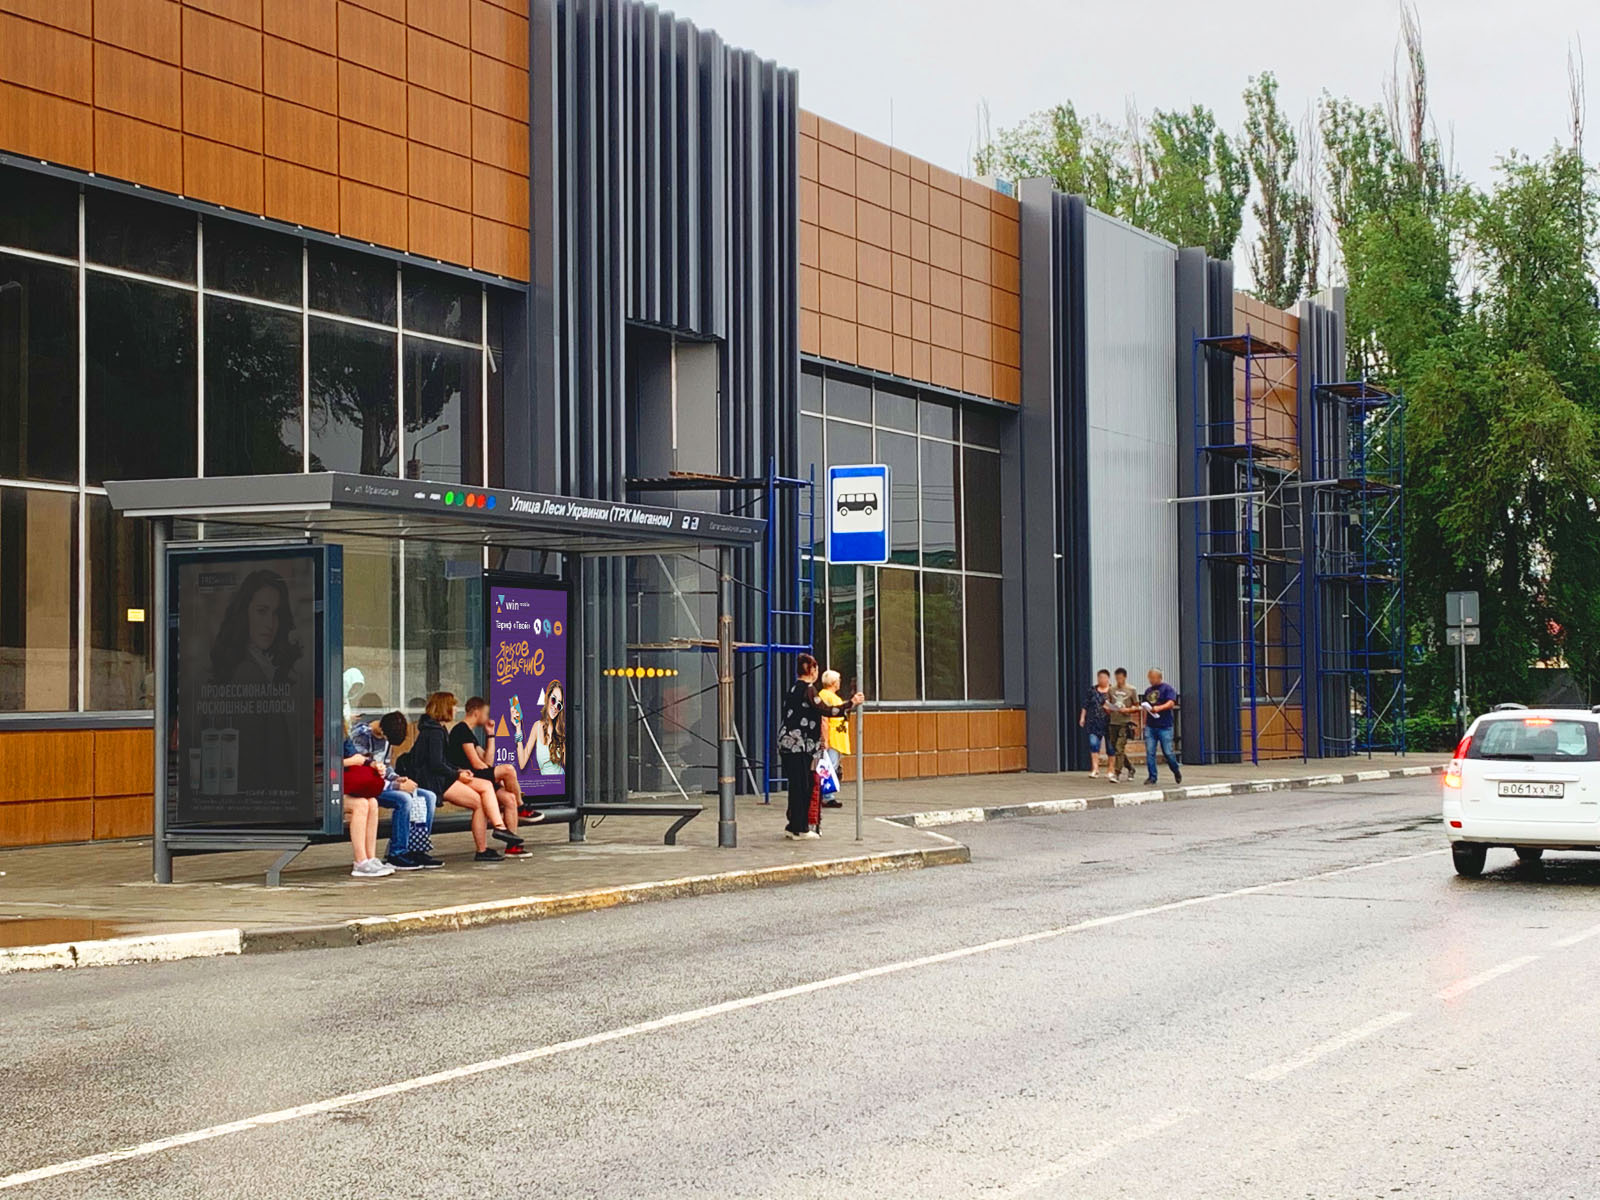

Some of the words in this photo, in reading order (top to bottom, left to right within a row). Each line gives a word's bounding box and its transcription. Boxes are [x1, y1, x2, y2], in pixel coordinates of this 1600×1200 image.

[510, 496, 539, 514] Улица
[540, 500, 566, 516] Леси
[566, 502, 608, 521] Украинки
[609, 506, 632, 523] (ТРК
[631, 509, 673, 528] Меганом)
[505, 599, 519, 610] win
[201, 683, 290, 698] ПРОФЕССИОНАЛЬНО
[196, 699, 255, 714] РОСКОШНЫЕ
[256, 698, 295, 713] ВОЛОСЫ
[496, 747, 507, 761] 10
[1549, 784, 1560, 793] 82
